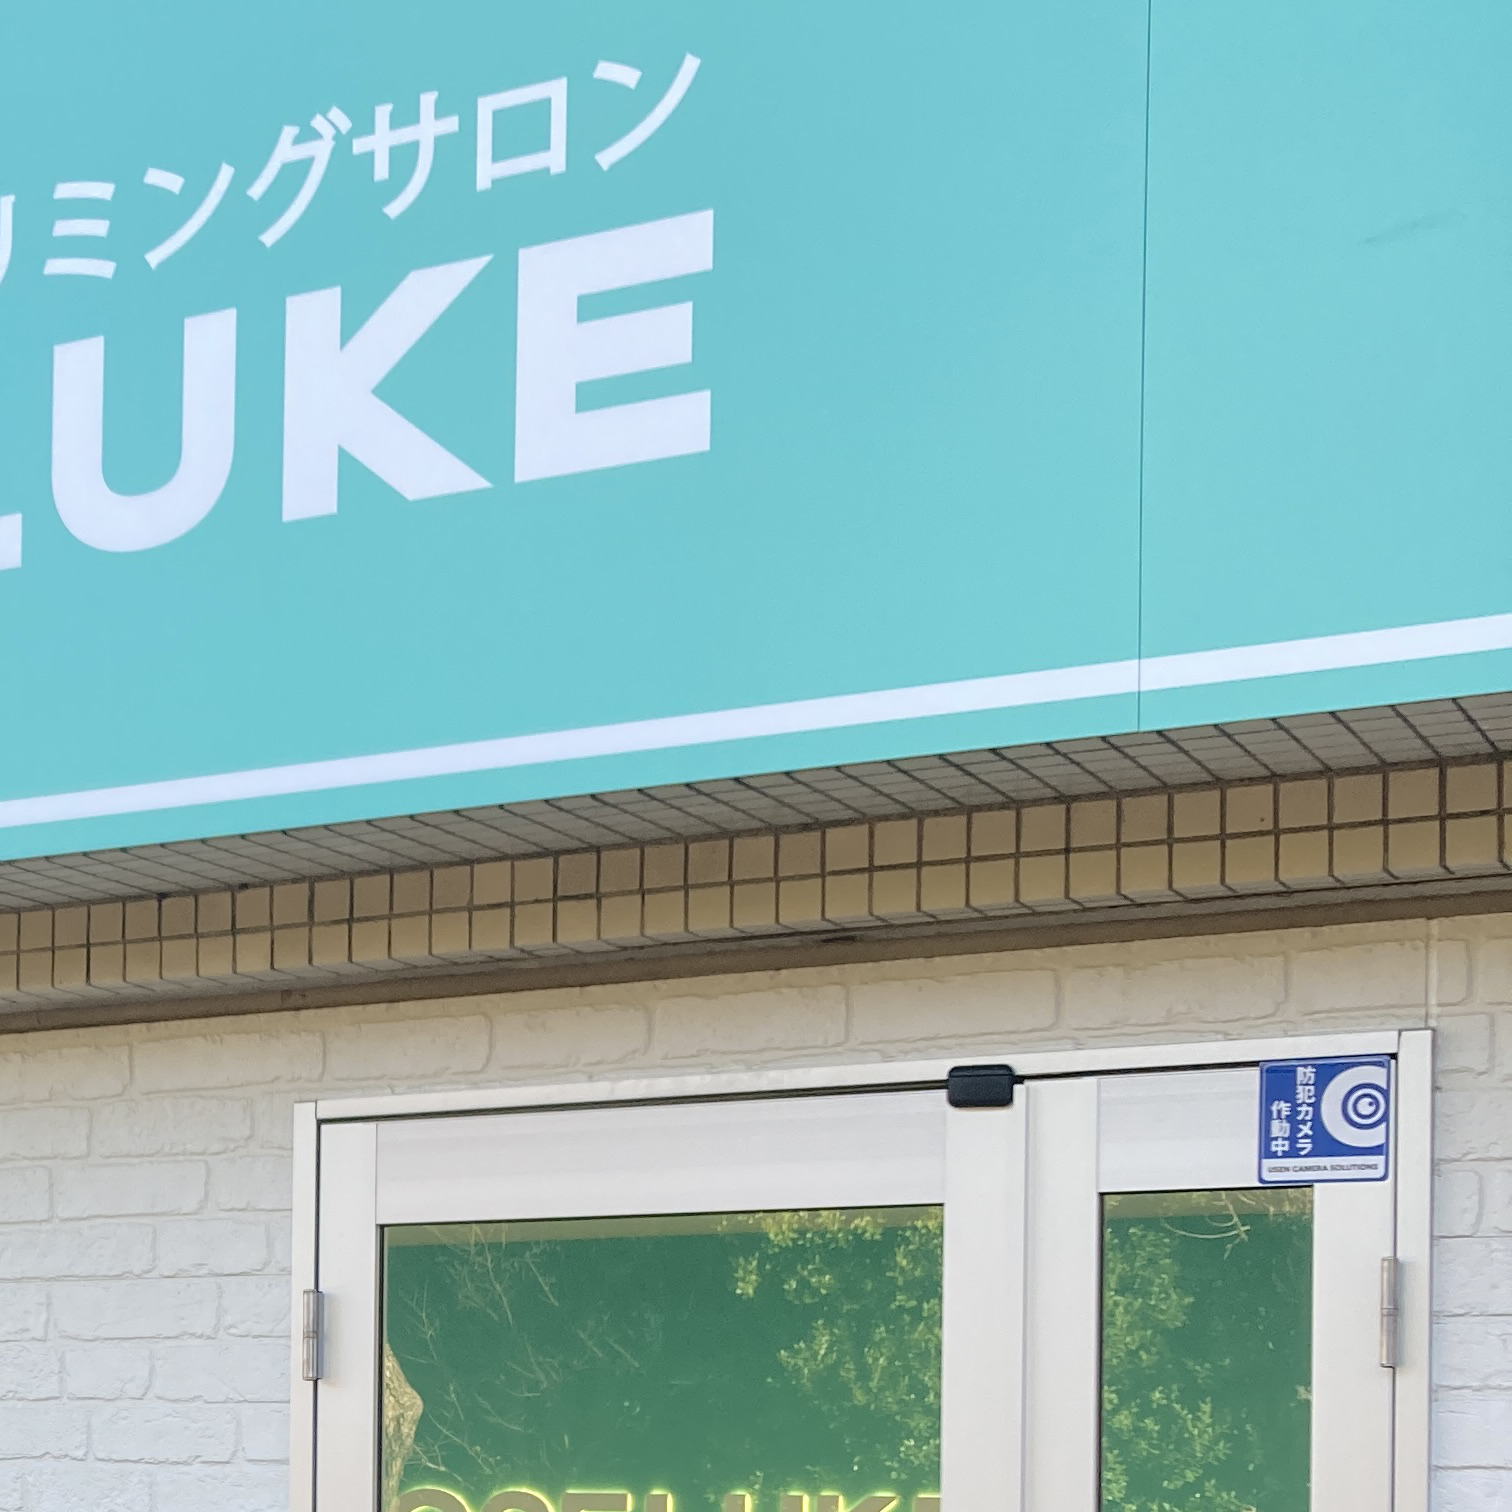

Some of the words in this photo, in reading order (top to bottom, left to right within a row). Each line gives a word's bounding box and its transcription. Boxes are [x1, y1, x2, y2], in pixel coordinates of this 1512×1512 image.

[1270, 1100, 1292, 1157] 作動中
[1295, 1065, 1317, 1156] 防犯カメラ
[1292, 1163, 1328, 1173] CAMERA
[1329, 1162, 1379, 1172] SOLUTIONS
